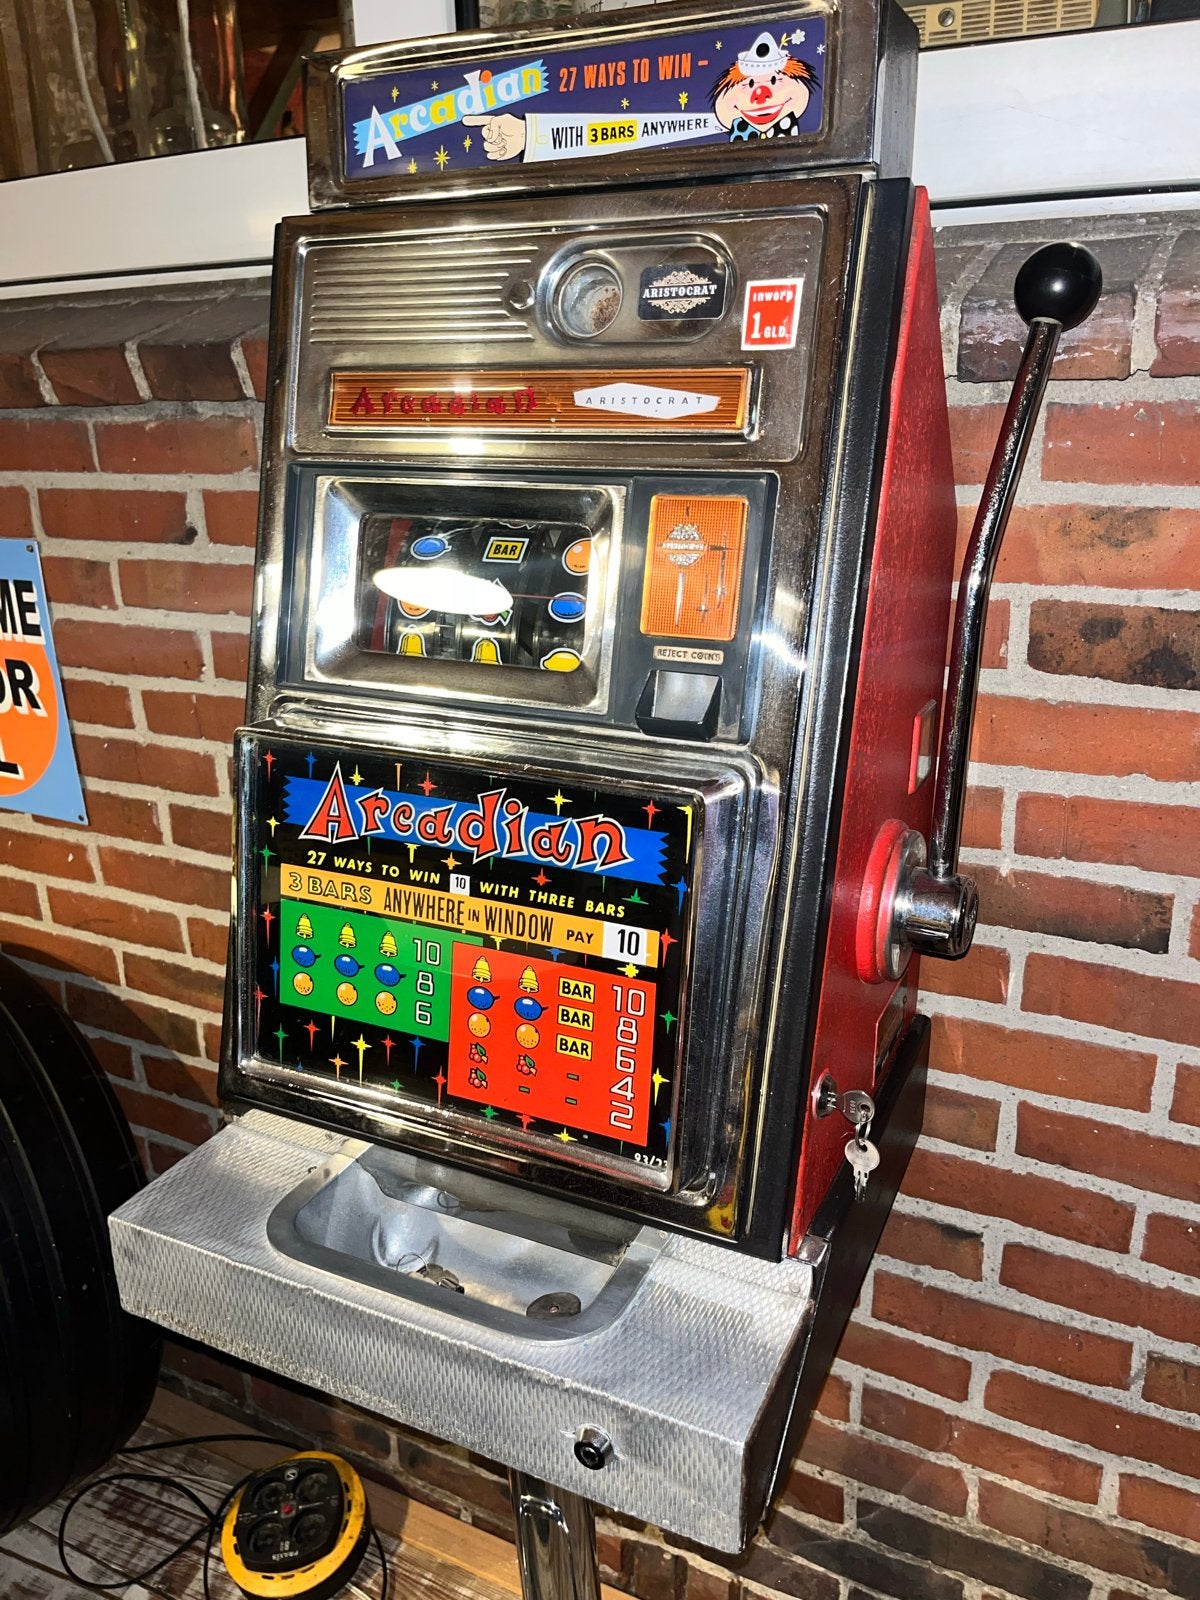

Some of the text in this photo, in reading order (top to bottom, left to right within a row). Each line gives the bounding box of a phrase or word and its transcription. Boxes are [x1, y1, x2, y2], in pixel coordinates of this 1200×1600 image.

[559, 66, 578, 93] 27
[583, 60, 627, 89] WAYS
[632, 57, 650, 84] TO
[658, 52, 692, 81] WIN
[362, 69, 542, 168] Arcadian
[551, 125, 584, 150] WITH
[641, 118, 709, 138] ANYWHERE
[642, 284, 718, 299] ARISTOCRAT
[752, 289, 793, 303] inworp
[750, 311, 761, 339] 1
[350, 386, 538, 418] Arcadian
[585, 396, 703, 406] ARISTOCRAT
[493, 544, 518, 556] BAR
[657, 648, 722, 663] REJECT COINS
[0, 658, 43, 711] R
[298, 760, 635, 873] Arcadian
[307, 850, 626, 918] 27 WAYS TO WIN 10 WITH THREE BARS
[288, 872, 641, 957] 3 BARS ANYWHERE IN WINDOW PAY 10
[412, 937, 442, 967] 10
[416, 970, 435, 996] 8
[561, 980, 647, 1018] BAR 10
[415, 1000, 432, 1026] 6
[560, 1008, 638, 1046] BAR 8
[558, 1036, 637, 1074] BAR 6
[609, 1075, 635, 1102] 4
[609, 1100, 635, 1131] 2
